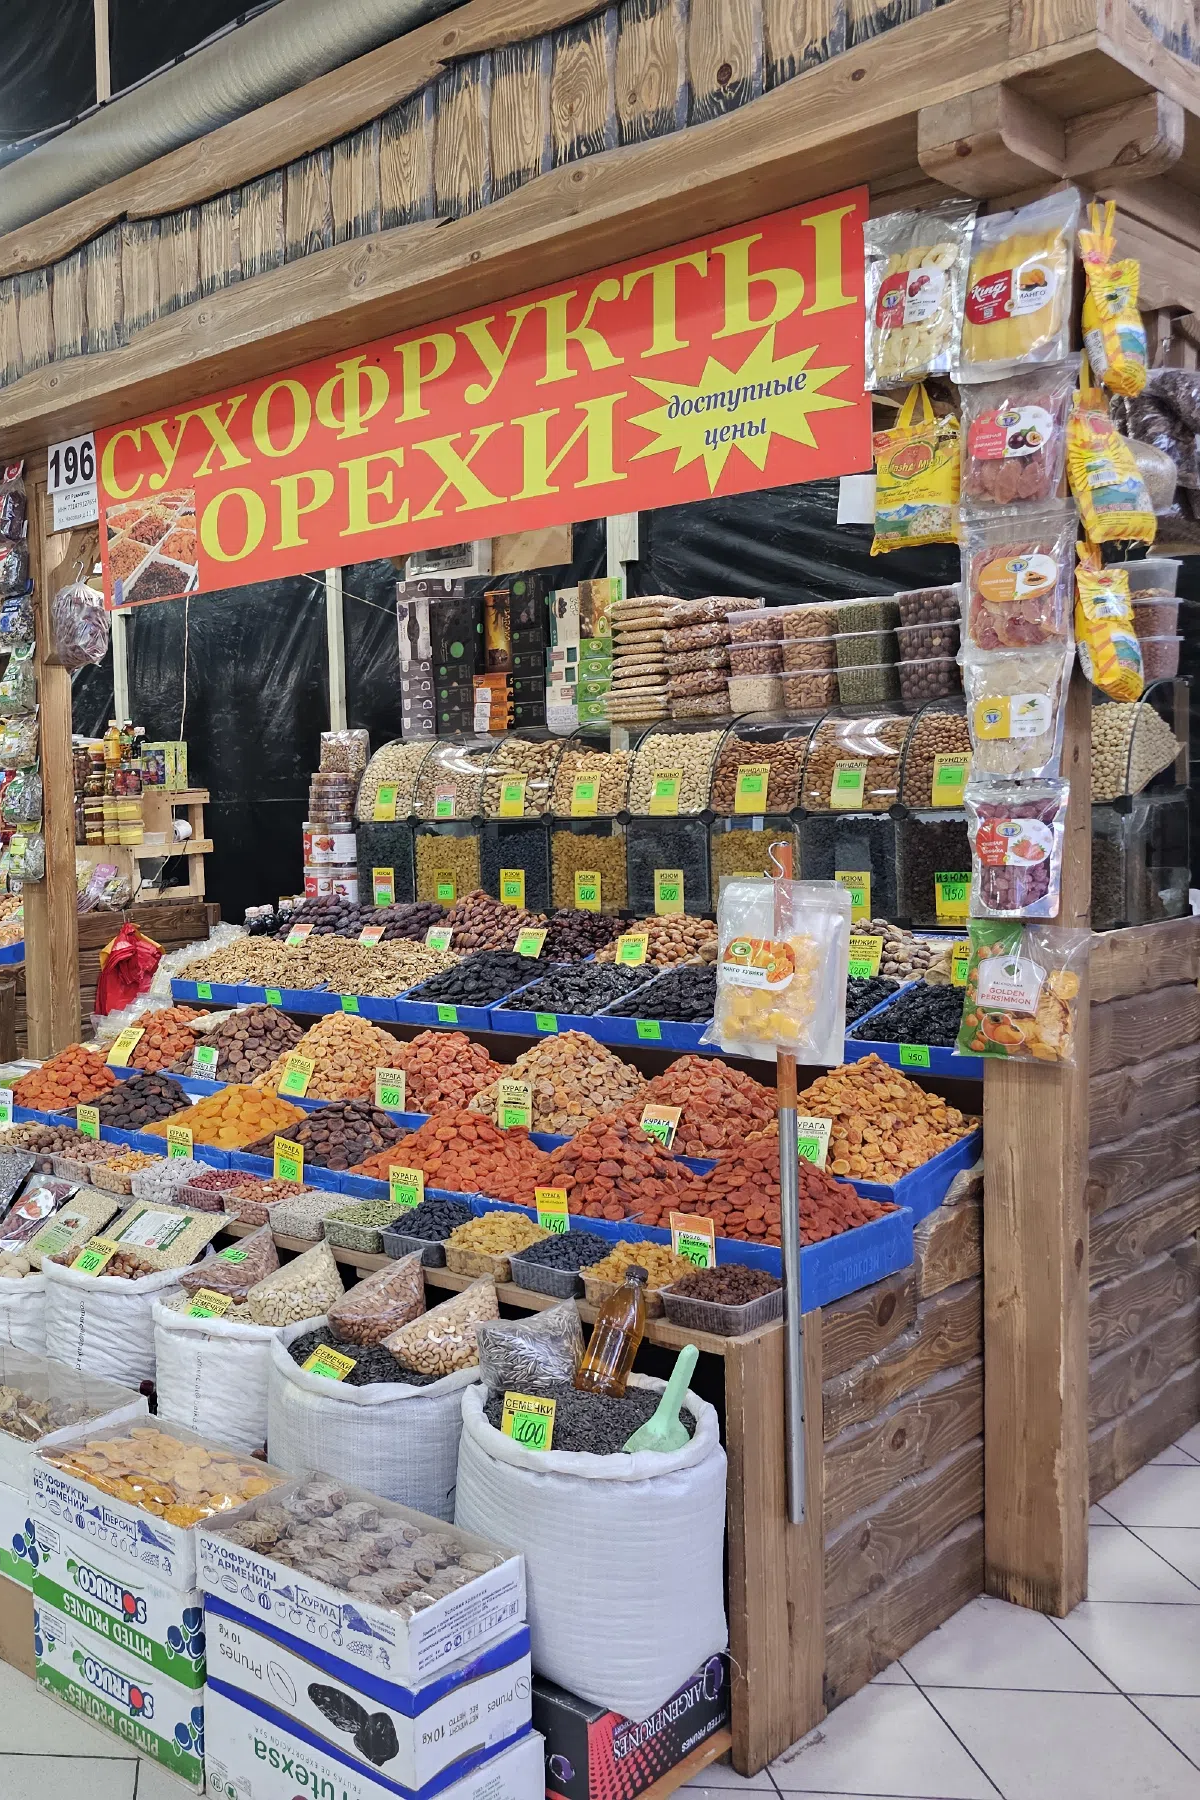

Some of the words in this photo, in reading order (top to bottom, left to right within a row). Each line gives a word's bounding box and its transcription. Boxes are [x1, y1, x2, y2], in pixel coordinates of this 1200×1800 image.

[971, 281, 1008, 303] King
[100, 203, 860, 500] СУХОФРУКТЫ
[666, 368, 810, 421] доступные
[703, 414, 769, 456] цены
[49, 440, 95, 489] 196
[199, 391, 632, 563] ОРЕХИ
[835, 761, 867, 769] МИНДАЛЬ
[937, 756, 969, 764] ФУНДУК
[576, 774, 598, 782] КЕШЬЮ
[656, 771, 680, 779] КЕШЬЮ
[738, 766, 769, 774] МИНДАЛЬ
[659, 872, 679, 880] ИЗЮМ
[840, 875, 863, 883] ИЗЮМ
[936, 873, 968, 883] ИЗЮМ
[579, 889, 596, 901] 800
[659, 889, 677, 901] 500
[944, 886, 964, 901] 450
[980, 993, 1031, 1006] PERSIMMON
[989, 987, 1025, 997] GOLDEN
[291, 1057, 312, 1069] КУРАГА
[908, 1053, 923, 1062] 450
[378, 1071, 402, 1080] КУРАГА
[502, 1084, 529, 1093] КУРАГА
[381, 1090, 399, 1106] 800
[643, 1117, 671, 1127] КУРАГА
[798, 1121, 826, 1130] УРАГА
[169, 1129, 189, 1138] КУРАГА
[276, 1141, 301, 1155] КУРАГА
[391, 1171, 418, 1182] КУРАГА
[399, 1194, 414, 1204] 800
[545, 1219, 566, 1234] 450
[190, 1298, 225, 1314] СЕМЕЧКИ
[315, 1348, 352, 1372] СЕМЕЧКИ
[505, 1398, 553, 1416] СЕМЕЧКИ
[515, 1419, 545, 1446] 100
[33, 1467, 89, 1504] СУХОФРУКТЫ
[33, 1477, 44, 1490] ИЗ
[45, 1484, 86, 1512] АРМЕНИИ
[105, 1512, 134, 1534] ПЕРСИК
[200, 1538, 277, 1582] СУХОФРУКТЫ
[200, 1551, 214, 1565] ИЗ
[217, 1558, 271, 1592] АРМЕНИИ
[62, 1592, 110, 1636] PRUNES
[300, 1593, 337, 1621] ХУРМА
[112, 1622, 153, 1662] PITTED
[231, 1633, 242, 1646] 10
[219, 1642, 263, 1680] Prunes
[67, 1683, 115, 1729] PRUNES
[487, 1689, 514, 1713] Prunes
[448, 1711, 467, 1727] НЕТТО
[469, 1712, 480, 1725] NET
[612, 1679, 705, 1762] ARGENPRUNES
[706, 1711, 727, 1732] PITTED
[448, 1719, 469, 1737] WEIGHT
[118, 1717, 159, 1757] PITTED
[681, 1730, 706, 1753] PRUNES
[254, 1736, 348, 1800] utexsa
[320, 1765, 331, 1775] DE
[332, 1772, 362, 1795] FRUTAS
